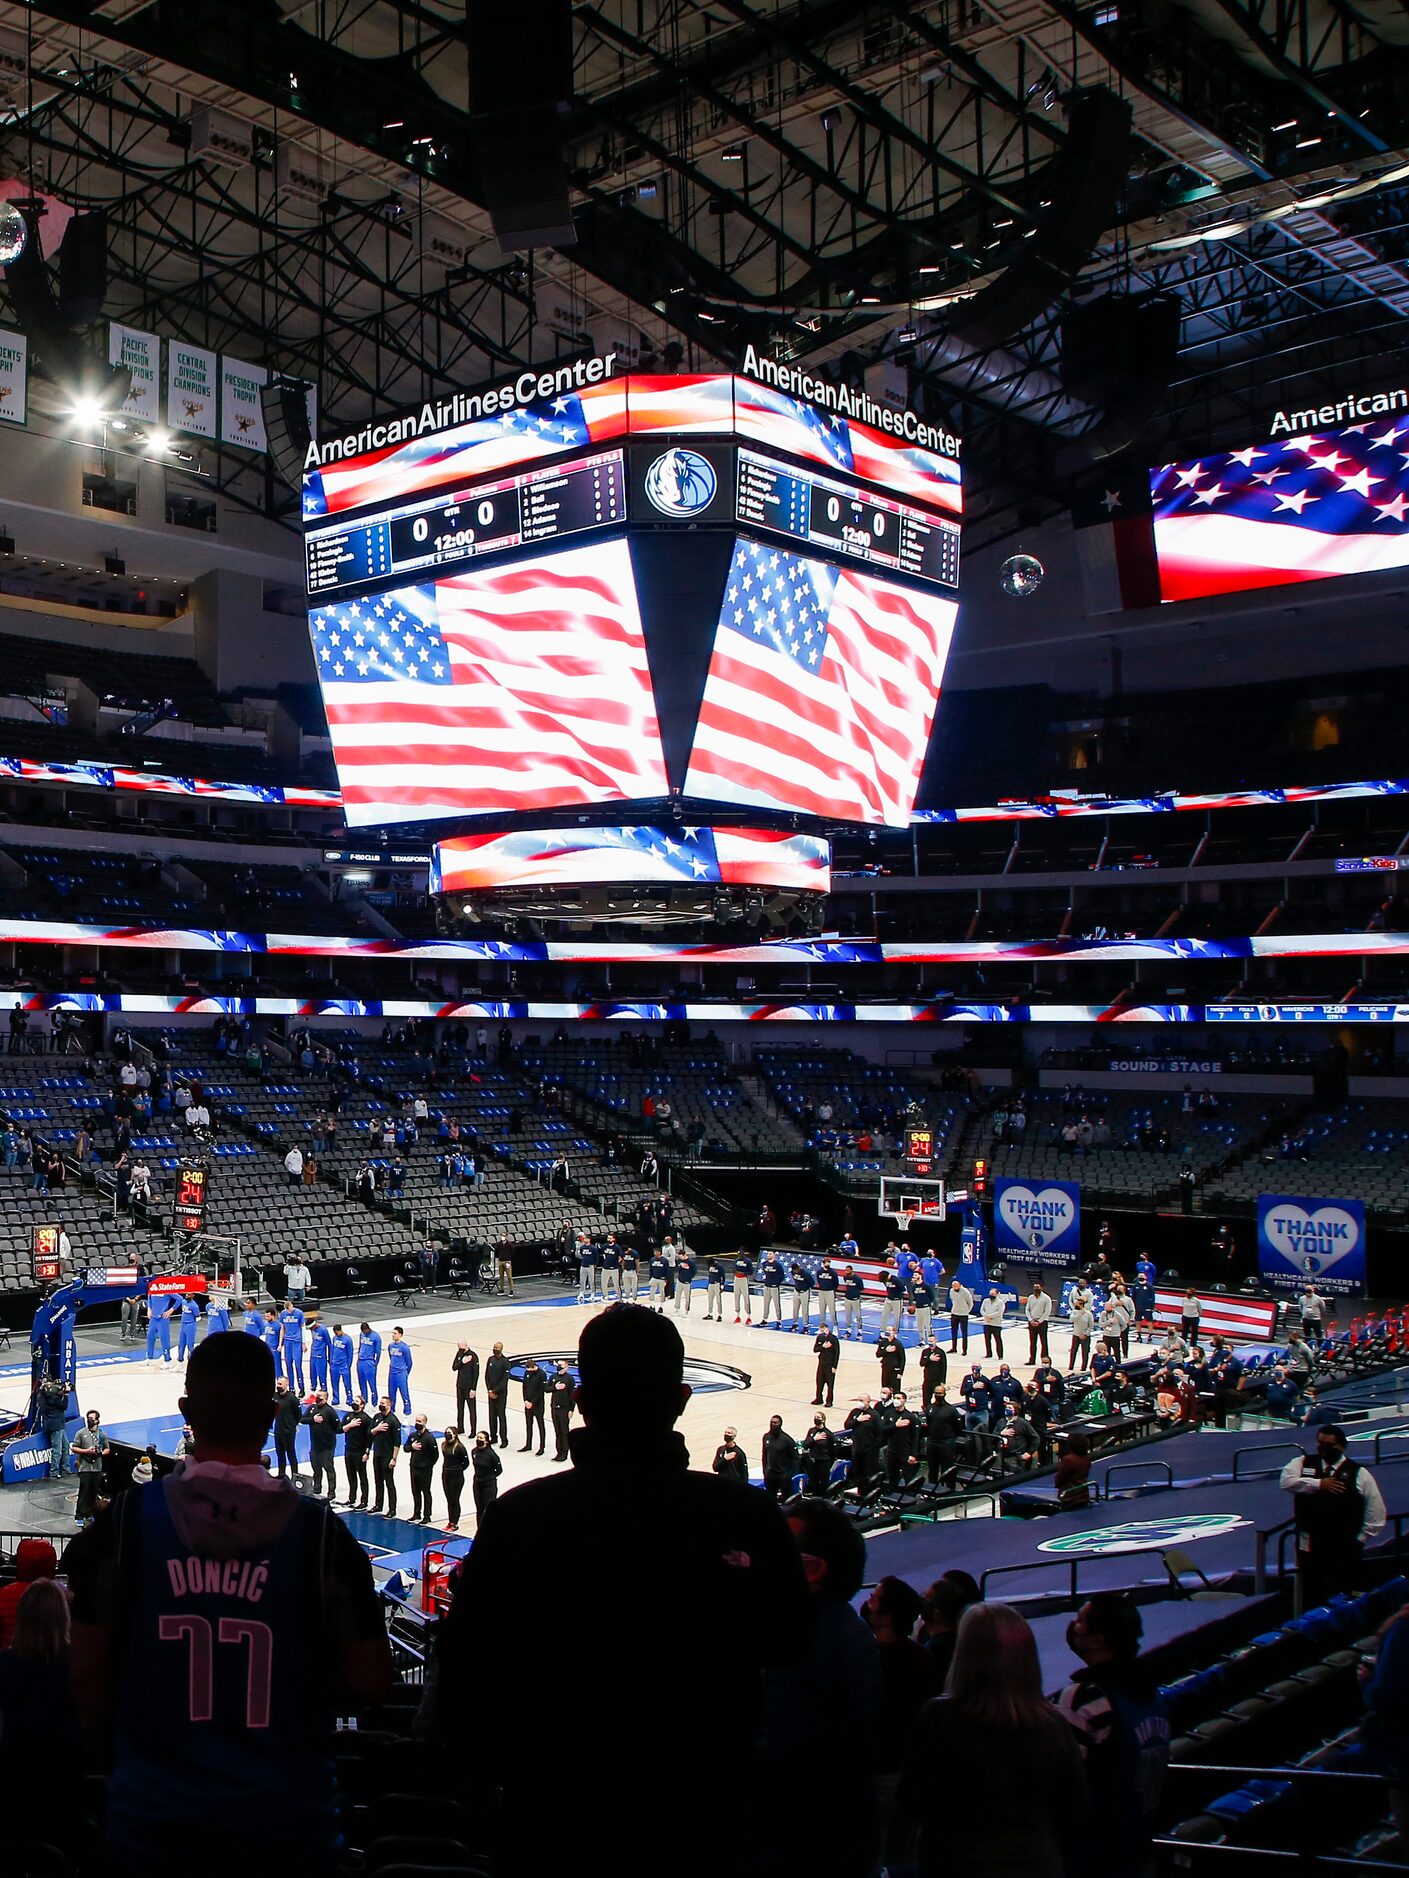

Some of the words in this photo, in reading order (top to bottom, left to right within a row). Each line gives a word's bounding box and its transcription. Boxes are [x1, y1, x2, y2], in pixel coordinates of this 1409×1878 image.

[122, 337, 147, 353] PACIFIC
[121, 350, 149, 367] DIVISION
[178, 353, 207, 371] CENTRAL
[179, 366, 206, 383] DIVISION
[174, 379, 210, 398] CHAMPIONS
[233, 389, 256, 405] TROPHY
[1270, 388, 1408, 435] American
[532, 468, 560, 481] PLAYER
[530, 478, 568, 493] Williamson
[531, 494, 545, 505] Ball
[444, 507, 460, 517] QTR
[477, 502, 493, 526] 0
[532, 502, 560, 515] Bledsoe
[827, 497, 839, 522] 0
[451, 519, 456, 527] 1
[523, 519, 531, 527] 12
[532, 513, 557, 525] Adams
[873, 513, 885, 537] 0
[413, 518, 428, 541] 0
[524, 530, 532, 538] 14
[533, 524, 557, 537] Ingram
[842, 525, 871, 547] 12:00
[434, 529, 474, 551] 12:00
[311, 580, 317, 588] 77
[1111, 1061, 1158, 1071] SOUND
[1170, 1062, 1221, 1072] STAGE
[911, 1133, 930, 1142] 12:00
[911, 1142, 929, 1155] 24
[183, 1171, 203, 1184] 12:00
[182, 1183, 200, 1203] 24
[1007, 1199, 1066, 1217] THANK
[1018, 1215, 1053, 1231] YOU
[1273, 1219, 1348, 1239] THANK
[40, 1240, 53, 1252] 24
[1288, 1236, 1333, 1254] YOU
[998, 1248, 1037, 1256] HEALTHCARE
[1039, 1251, 1069, 1260] WORKERS
[1263, 1272, 1312, 1282] HEALTHCARE
[1314, 1277, 1352, 1286] WORKERS
[19, 1450, 36, 1469] NBA
[158, 1614, 273, 1728] 77
